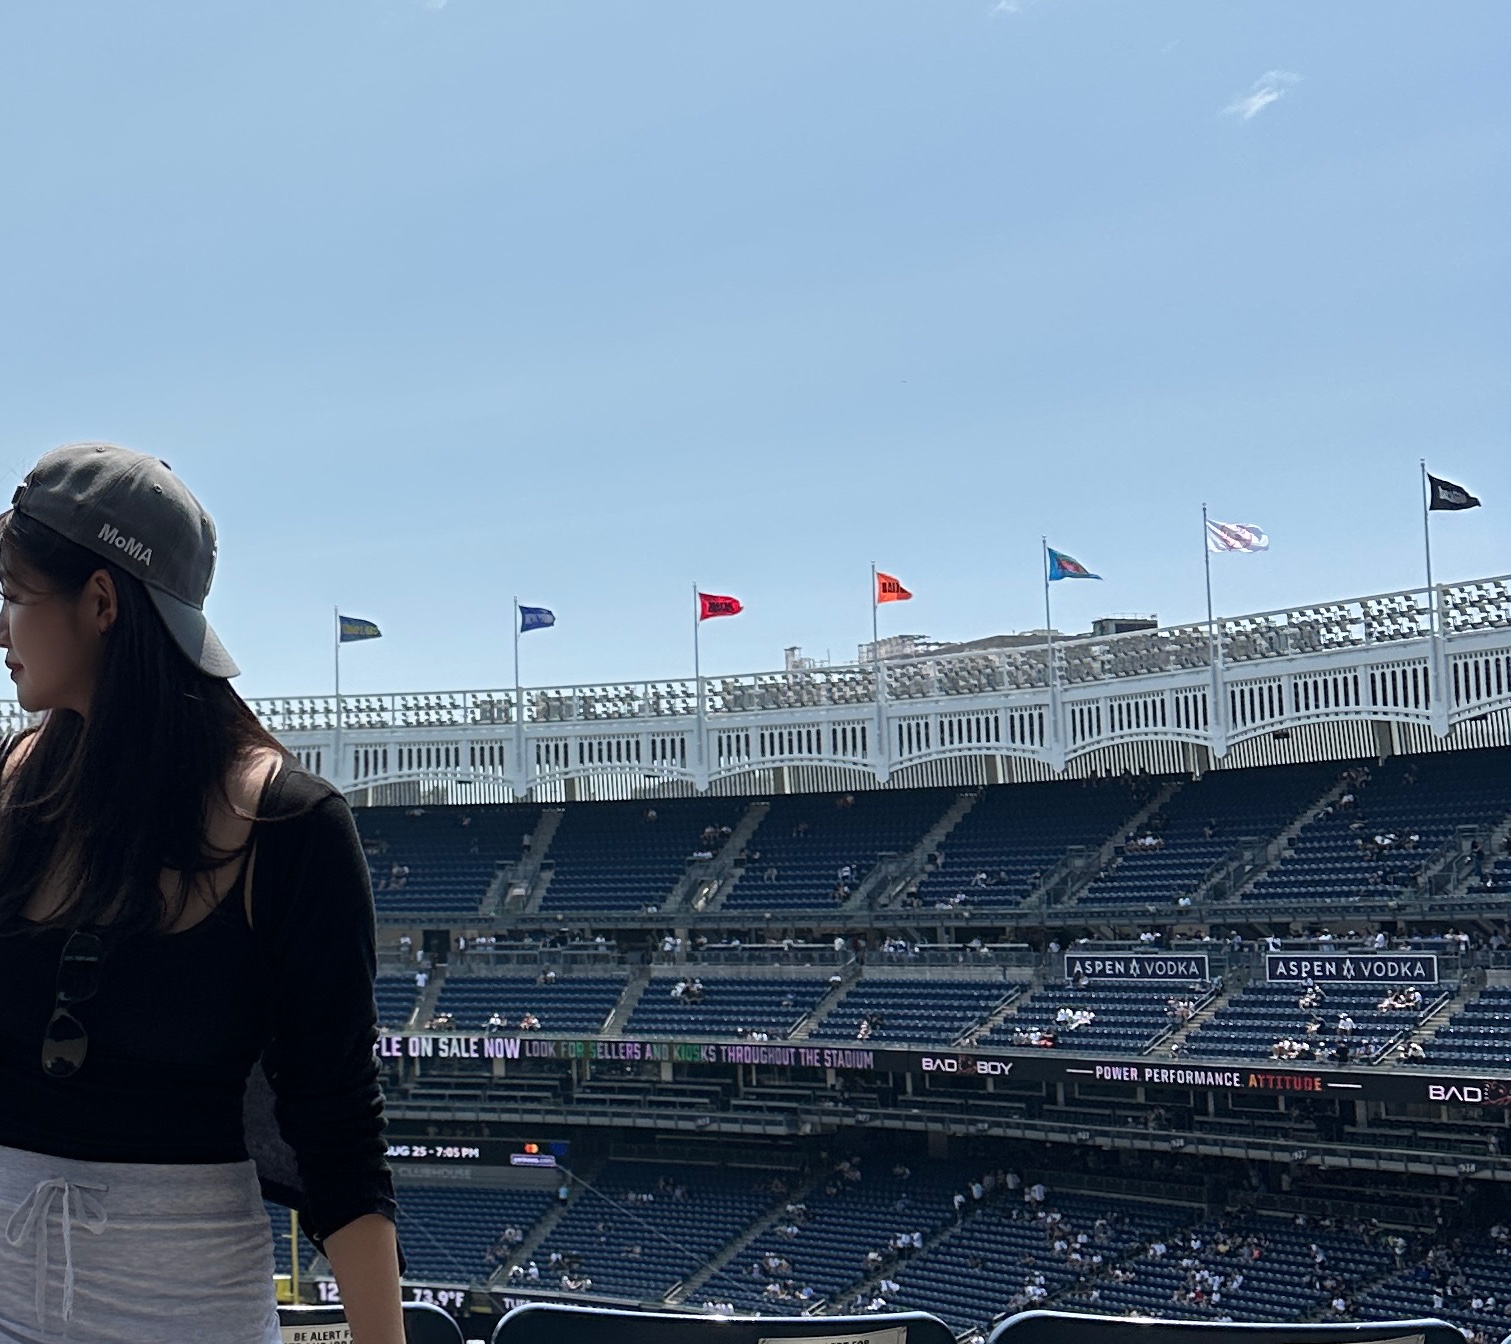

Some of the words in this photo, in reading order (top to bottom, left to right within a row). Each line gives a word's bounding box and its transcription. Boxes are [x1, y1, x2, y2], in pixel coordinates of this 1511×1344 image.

[97, 523, 153, 566] MoMA
[1073, 959, 1125, 976] ASPEN
[1145, 960, 1200, 977] VODKA
[1276, 959, 1336, 977] ASPEN
[1360, 960, 1426, 978] VODKA
[409, 1037, 433, 1057] ON
[438, 1038, 479, 1058] SALE
[484, 1038, 521, 1059] NOW
[525, 1040, 556, 1058] LOOK
[560, 1041, 584, 1059] FOR
[589, 1041, 642, 1061] SELLERS
[645, 1043, 670, 1061] AND
[673, 1044, 717, 1063] KIOSKS
[720, 1045, 796, 1066] THROUGHOUT
[798, 1048, 820, 1067] THE
[824, 1049, 874, 1069] STADIUM
[922, 1057, 957, 1072] BAD
[977, 1061, 1013, 1076] BOY
[1095, 1065, 1141, 1083] POWER.
[1145, 1067, 1244, 1088] PERFORMANCE.
[1248, 1073, 1323, 1092] ATTITUDE
[1429, 1085, 1482, 1103] BAD
[412, 1146, 427, 1157] 25
[436, 1147, 460, 1158] 7:05
[462, 1148, 480, 1159] PM
[293, 1332, 307, 1342] BE
[309, 1330, 341, 1342] ALERT
